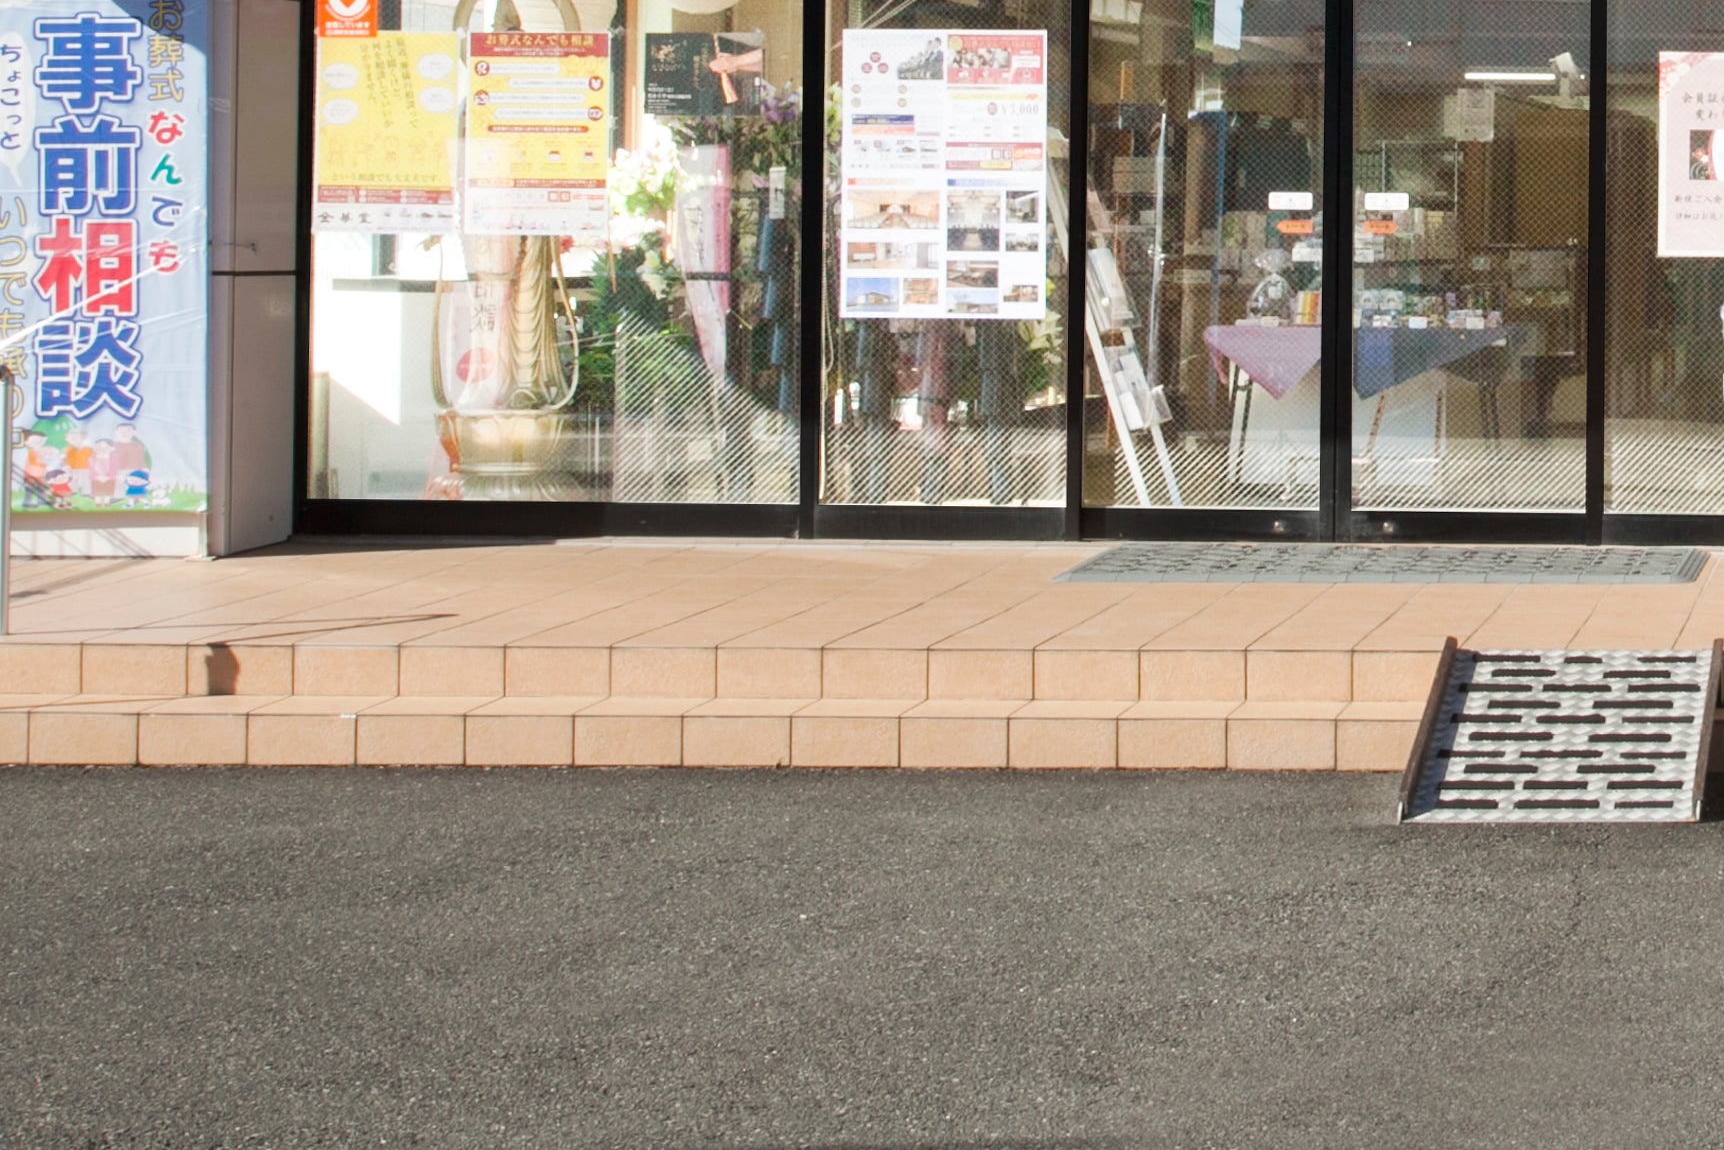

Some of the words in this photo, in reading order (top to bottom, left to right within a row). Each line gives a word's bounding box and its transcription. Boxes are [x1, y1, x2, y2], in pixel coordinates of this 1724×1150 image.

[0, 43, 22, 151] ちょこっと
[33, 12, 142, 419] 事前相談
